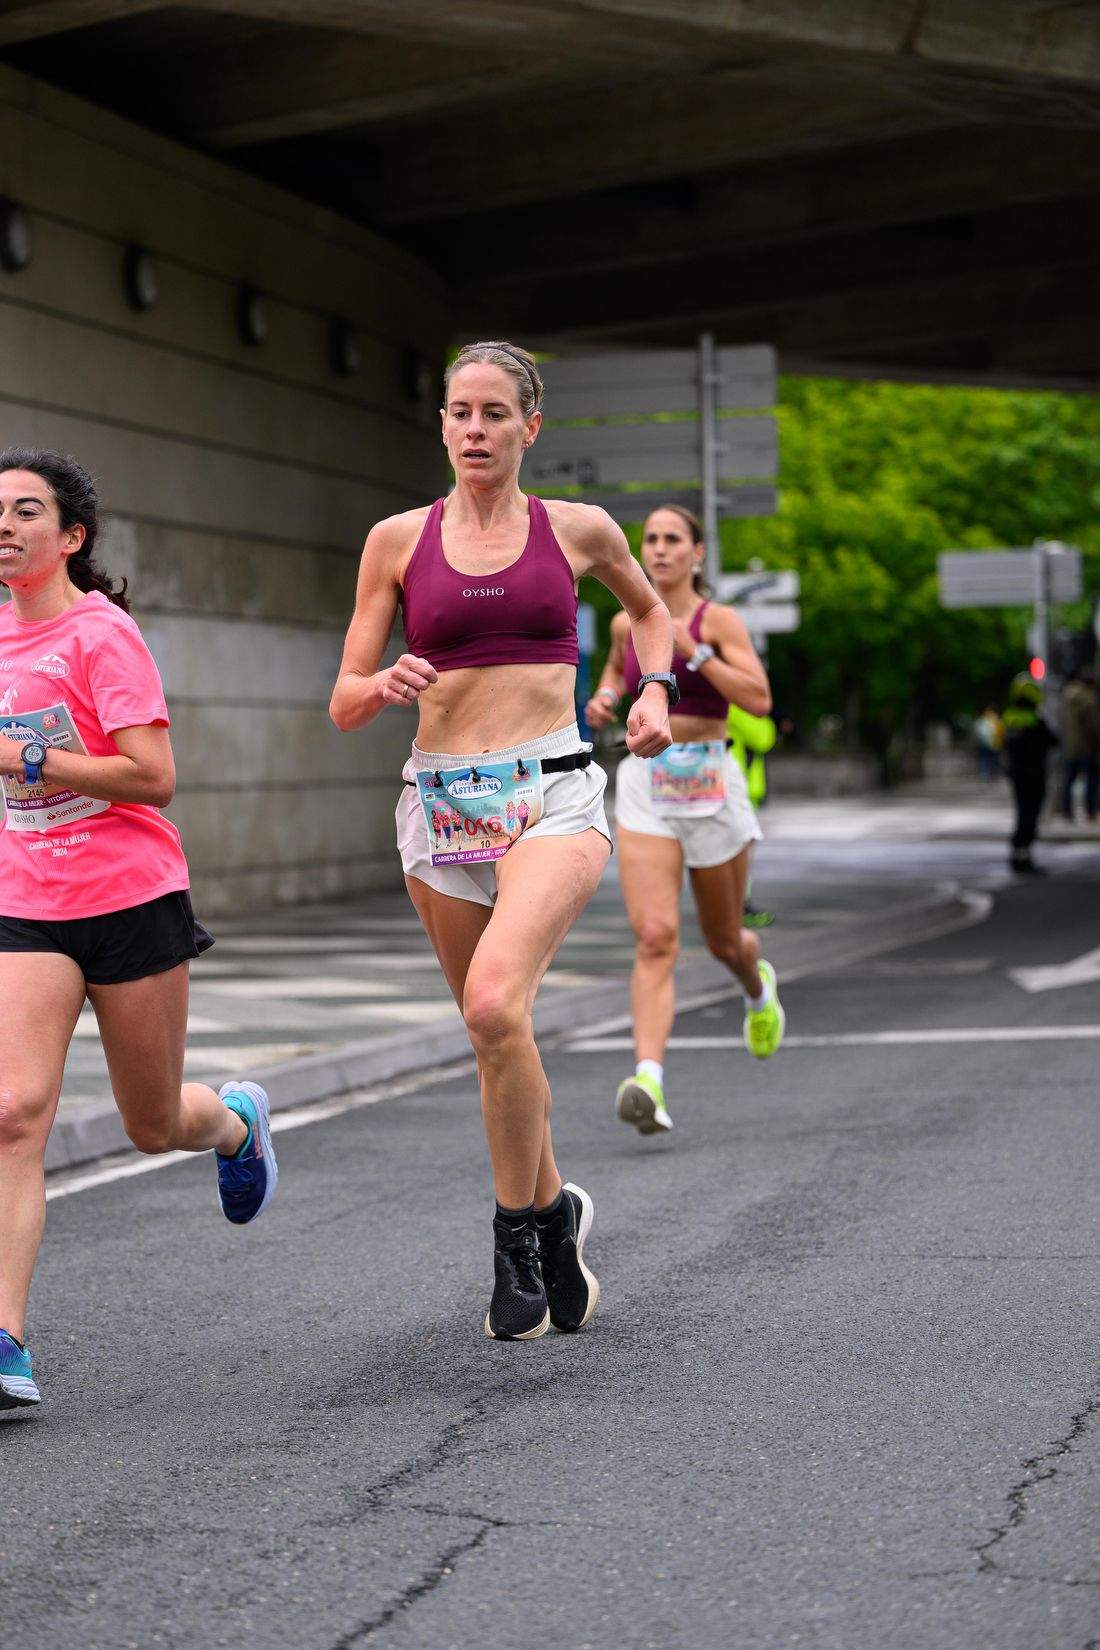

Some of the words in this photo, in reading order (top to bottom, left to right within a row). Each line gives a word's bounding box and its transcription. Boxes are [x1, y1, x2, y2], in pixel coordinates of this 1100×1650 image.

[462, 587, 505, 598] OYSHO
[44, 714, 57, 725] 20
[27, 788, 45, 798] 2145
[451, 783, 499, 795] ASTURIANA
[55, 800, 95, 818] Santander
[29, 840, 54, 851] CARRERA
[52, 838, 62, 848] DE
[61, 837, 71, 847] LA
[70, 831, 91, 845] MUJER
[481, 839, 491, 848] 10
[52, 846, 69, 858] 2024
[434, 854, 457, 863] CARRERA
[473, 850, 491, 858] MUJER
